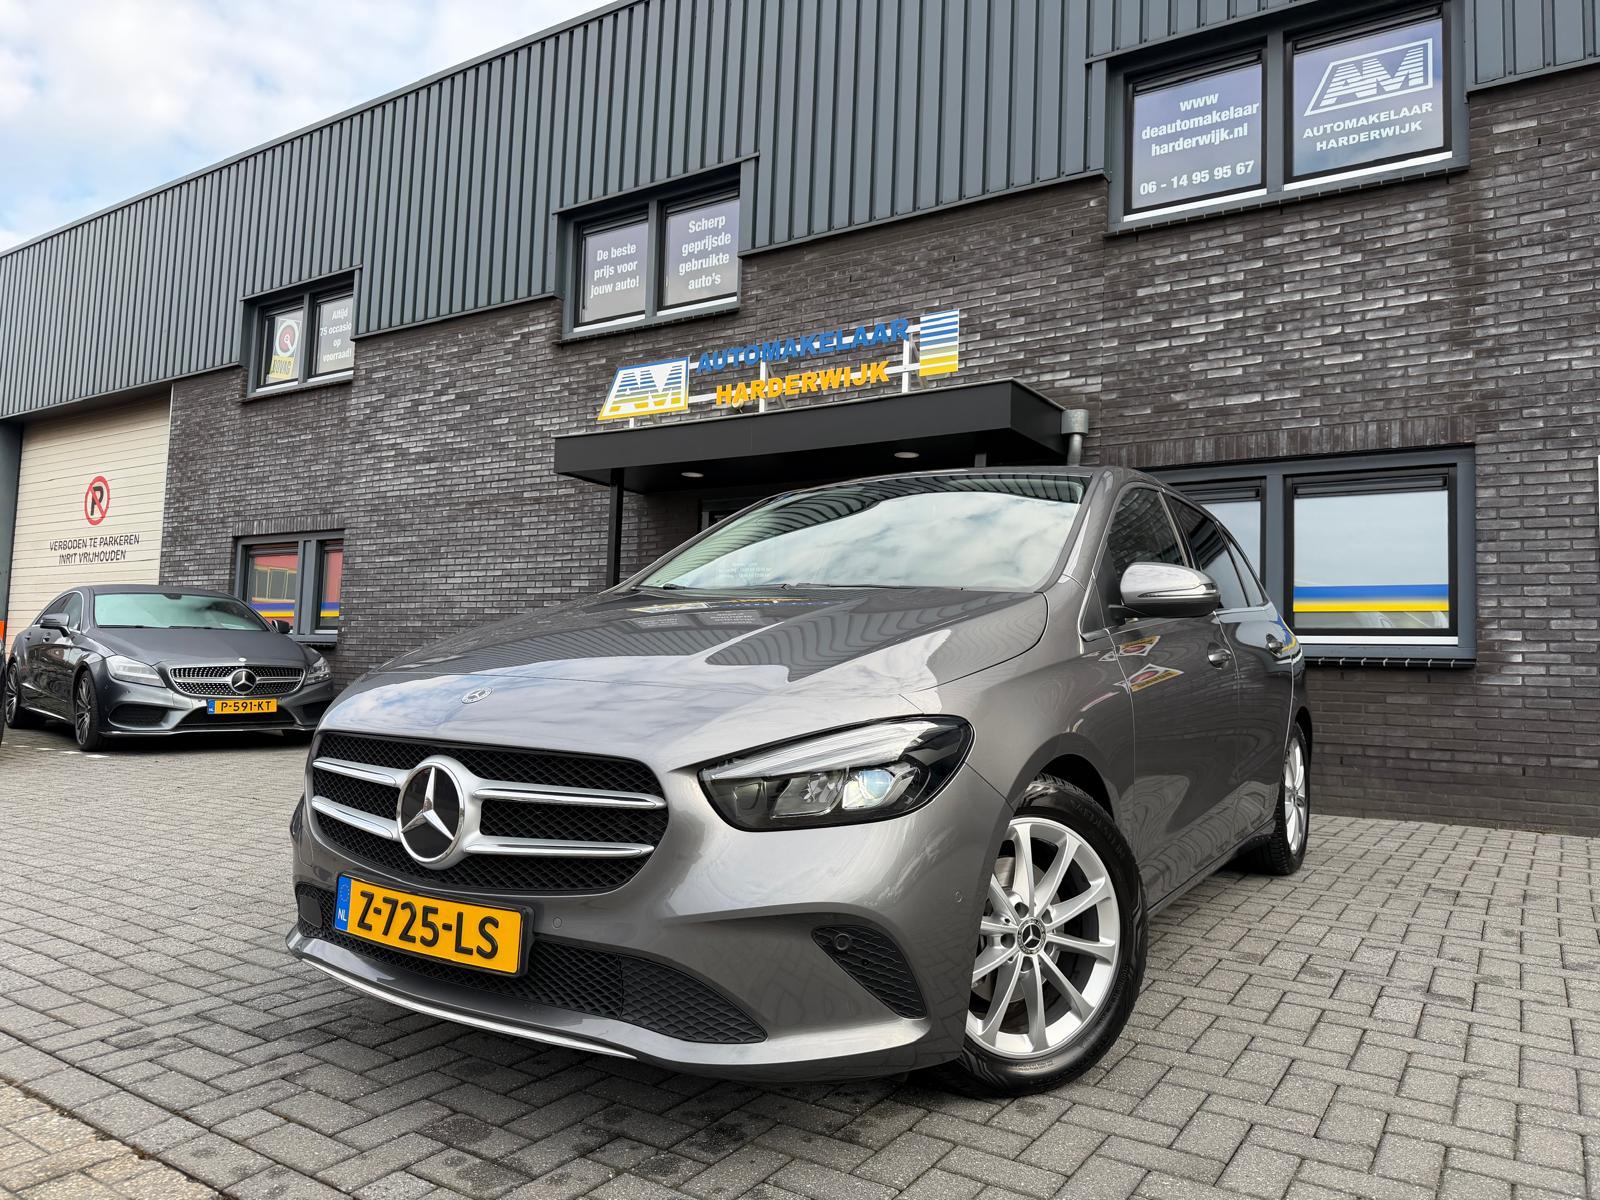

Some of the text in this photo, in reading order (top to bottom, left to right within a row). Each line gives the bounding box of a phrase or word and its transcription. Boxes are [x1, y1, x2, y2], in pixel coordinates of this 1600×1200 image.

[1179, 93, 1219, 112] www
[1141, 102, 1259, 141] deautomakelaar
[1303, 102, 1433, 139] AUTOMAKELAAR
[1151, 125, 1248, 157] harderwijk.nl
[1316, 120, 1423, 152] HARDERWIJK
[1139, 181, 1158, 196] 06
[1171, 174, 1188, 190] 14
[1191, 170, 1210, 186] 95
[1214, 165, 1232, 181] 95
[1236, 160, 1255, 176] 67
[688, 215, 726, 233] Scherp
[596, 243, 637, 262] De beste
[681, 232, 731, 256] geprijsde
[594, 261, 638, 281] prijs voor
[679, 252, 730, 276] gebruikte
[590, 275, 640, 299] jouw auto!
[688, 272, 721, 290] auto's
[695, 318, 911, 375] AUTOMAKELAAR
[715, 360, 891, 407] HARDERWIJK
[49, 534, 140, 551] VERBODEN TE PARKEREN
[59, 549, 127, 565] INRIT VRIJHOUDEN
[221, 700, 272, 712] P-591-KT
[337, 908, 347, 922] NL
[357, 890, 500, 960] Z-725-LS
